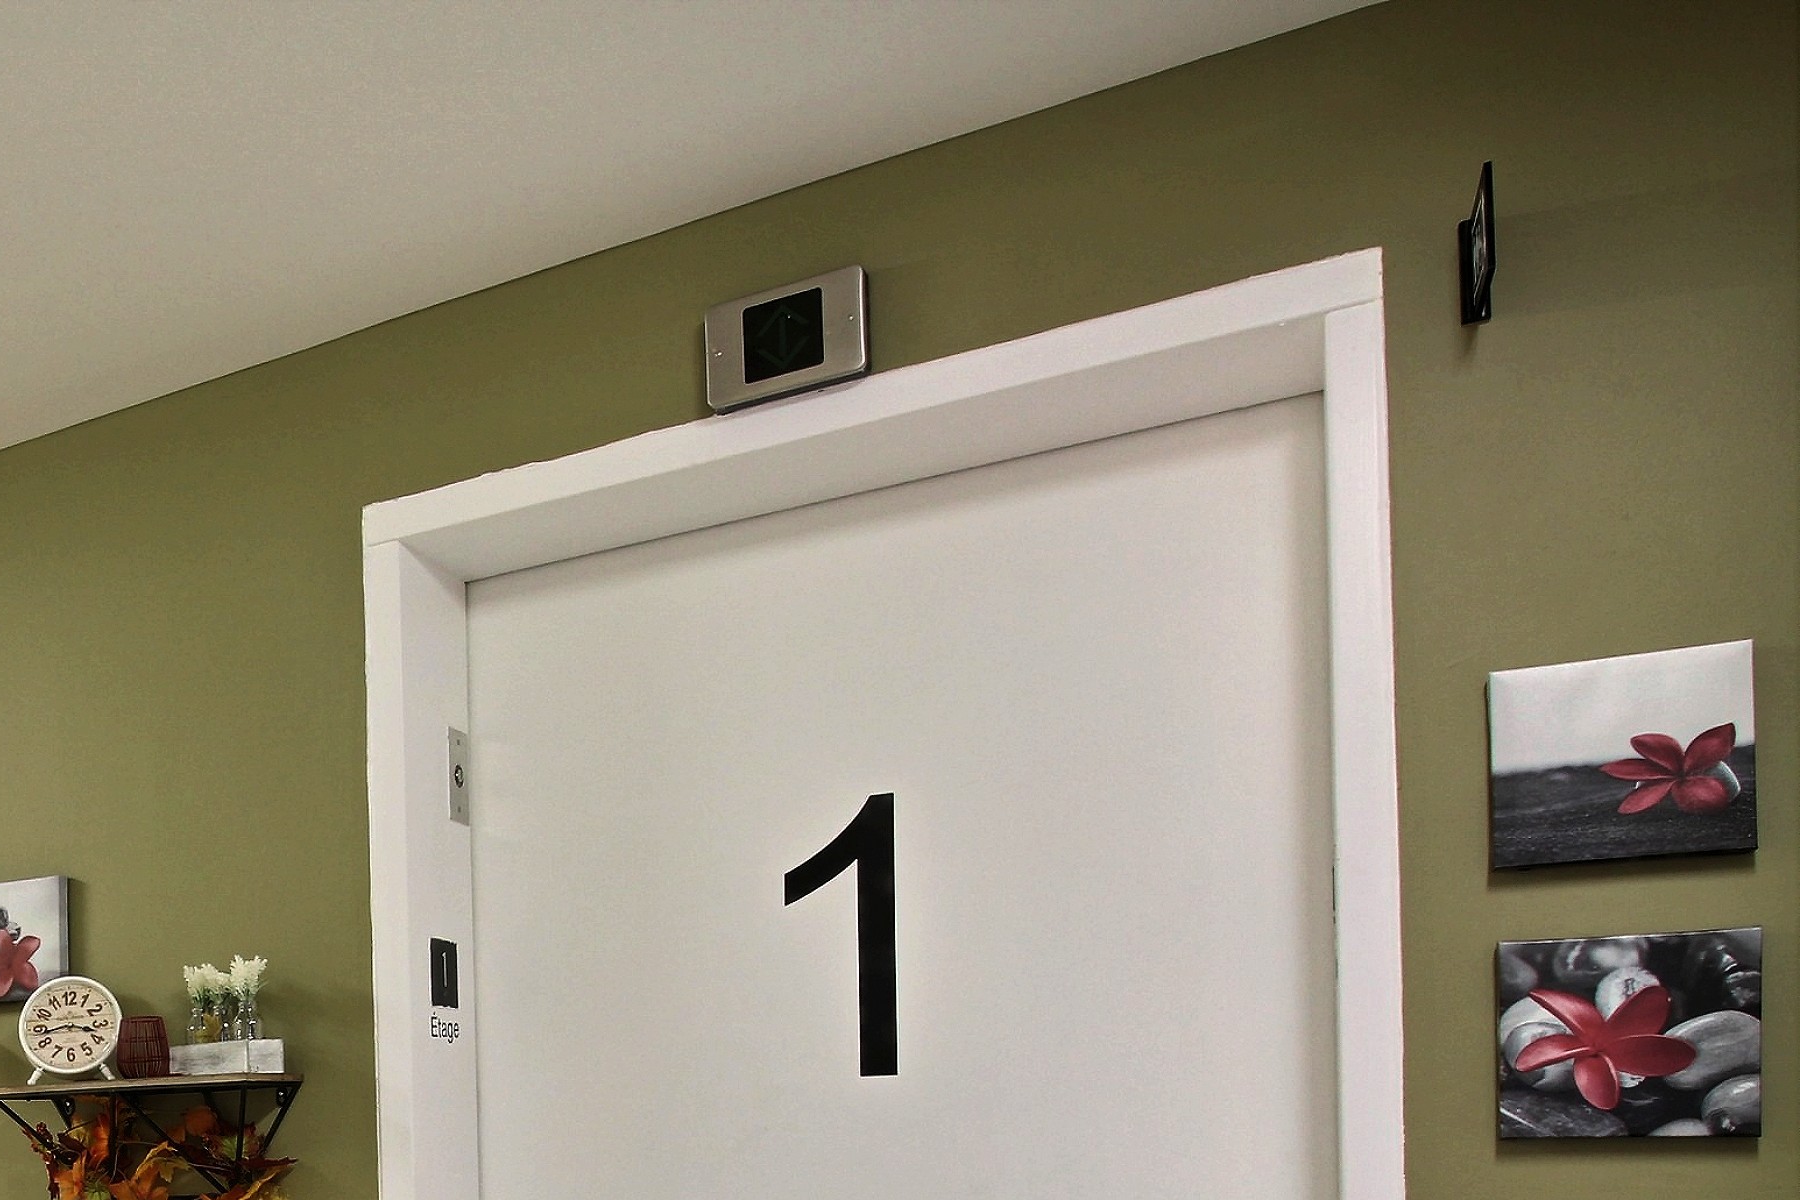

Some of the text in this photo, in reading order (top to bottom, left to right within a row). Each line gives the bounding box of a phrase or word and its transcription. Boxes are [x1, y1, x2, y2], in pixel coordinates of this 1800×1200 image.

[783, 792, 898, 1076] 1
[441, 951, 448, 988] 1
[48, 995, 62, 1011] 11
[62, 991, 77, 1006] 12
[80, 993, 90, 1008] 1
[36, 1008, 52, 1021] 10
[86, 1003, 103, 1017] 2
[33, 1024, 48, 1035] 9
[92, 1019, 109, 1028] 3
[431, 1011, 460, 1044] Étage
[38, 1036, 52, 1049] 8
[90, 1033, 105, 1045] 4
[51, 1044, 64, 1058] 7
[66, 1047, 76, 1062] 6
[80, 1041, 93, 1056] 5
